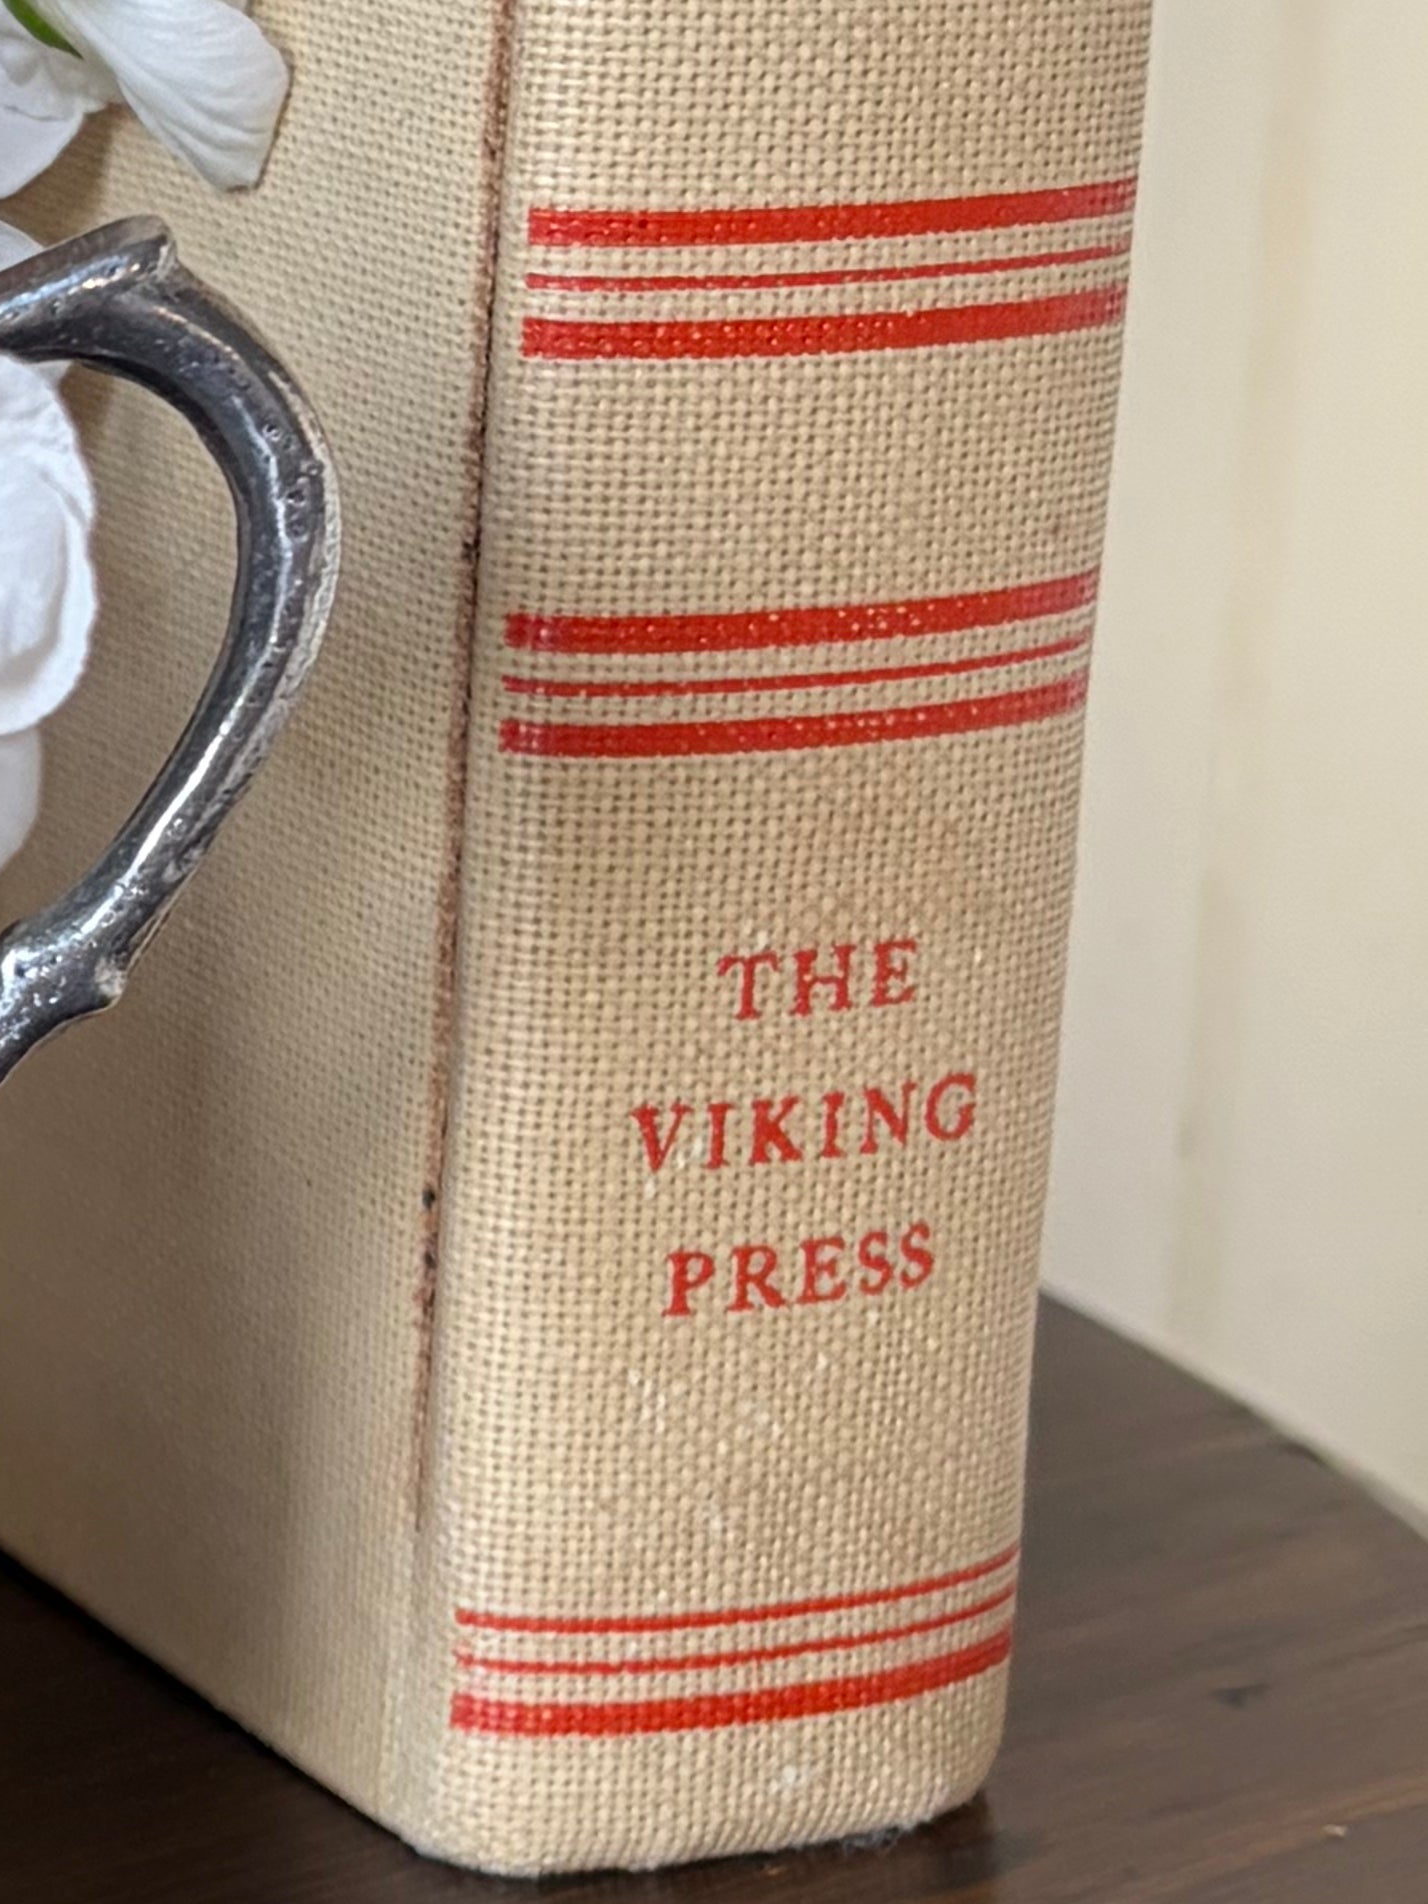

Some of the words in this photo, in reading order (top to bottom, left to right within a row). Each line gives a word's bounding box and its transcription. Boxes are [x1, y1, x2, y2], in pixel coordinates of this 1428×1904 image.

[716, 937, 919, 1021] THE
[630, 1072, 977, 1174] VIKING
[661, 1222, 935, 1318] PRESS
